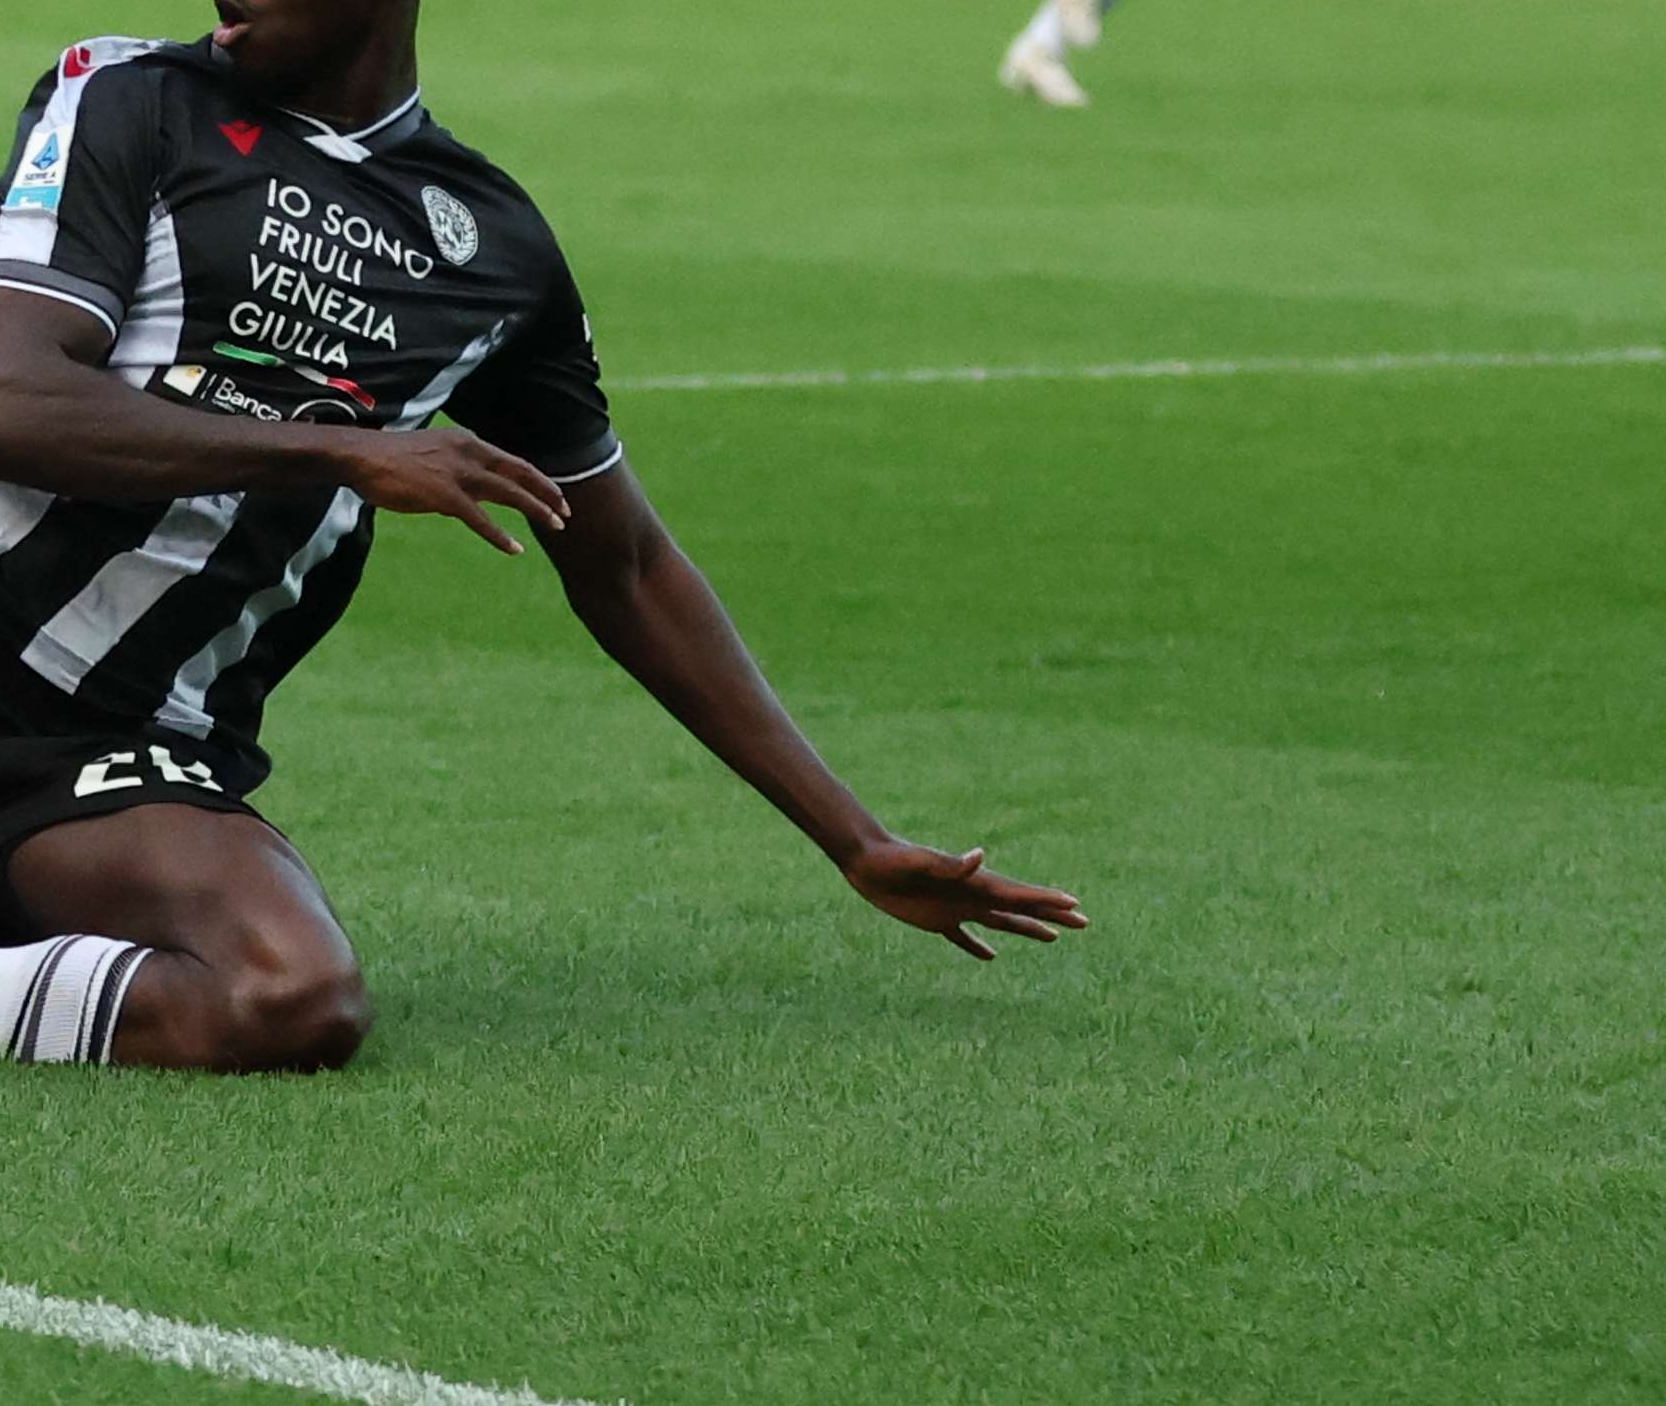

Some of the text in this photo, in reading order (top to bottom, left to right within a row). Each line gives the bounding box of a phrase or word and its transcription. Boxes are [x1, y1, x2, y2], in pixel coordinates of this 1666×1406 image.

[259, 215, 363, 286] FRIULI
[268, 178, 312, 218] IO
[321, 203, 434, 279] SONO
[229, 301, 349, 370] GIULIA
[250, 253, 397, 351] VENEZIA
[216, 376, 283, 422] Banca
